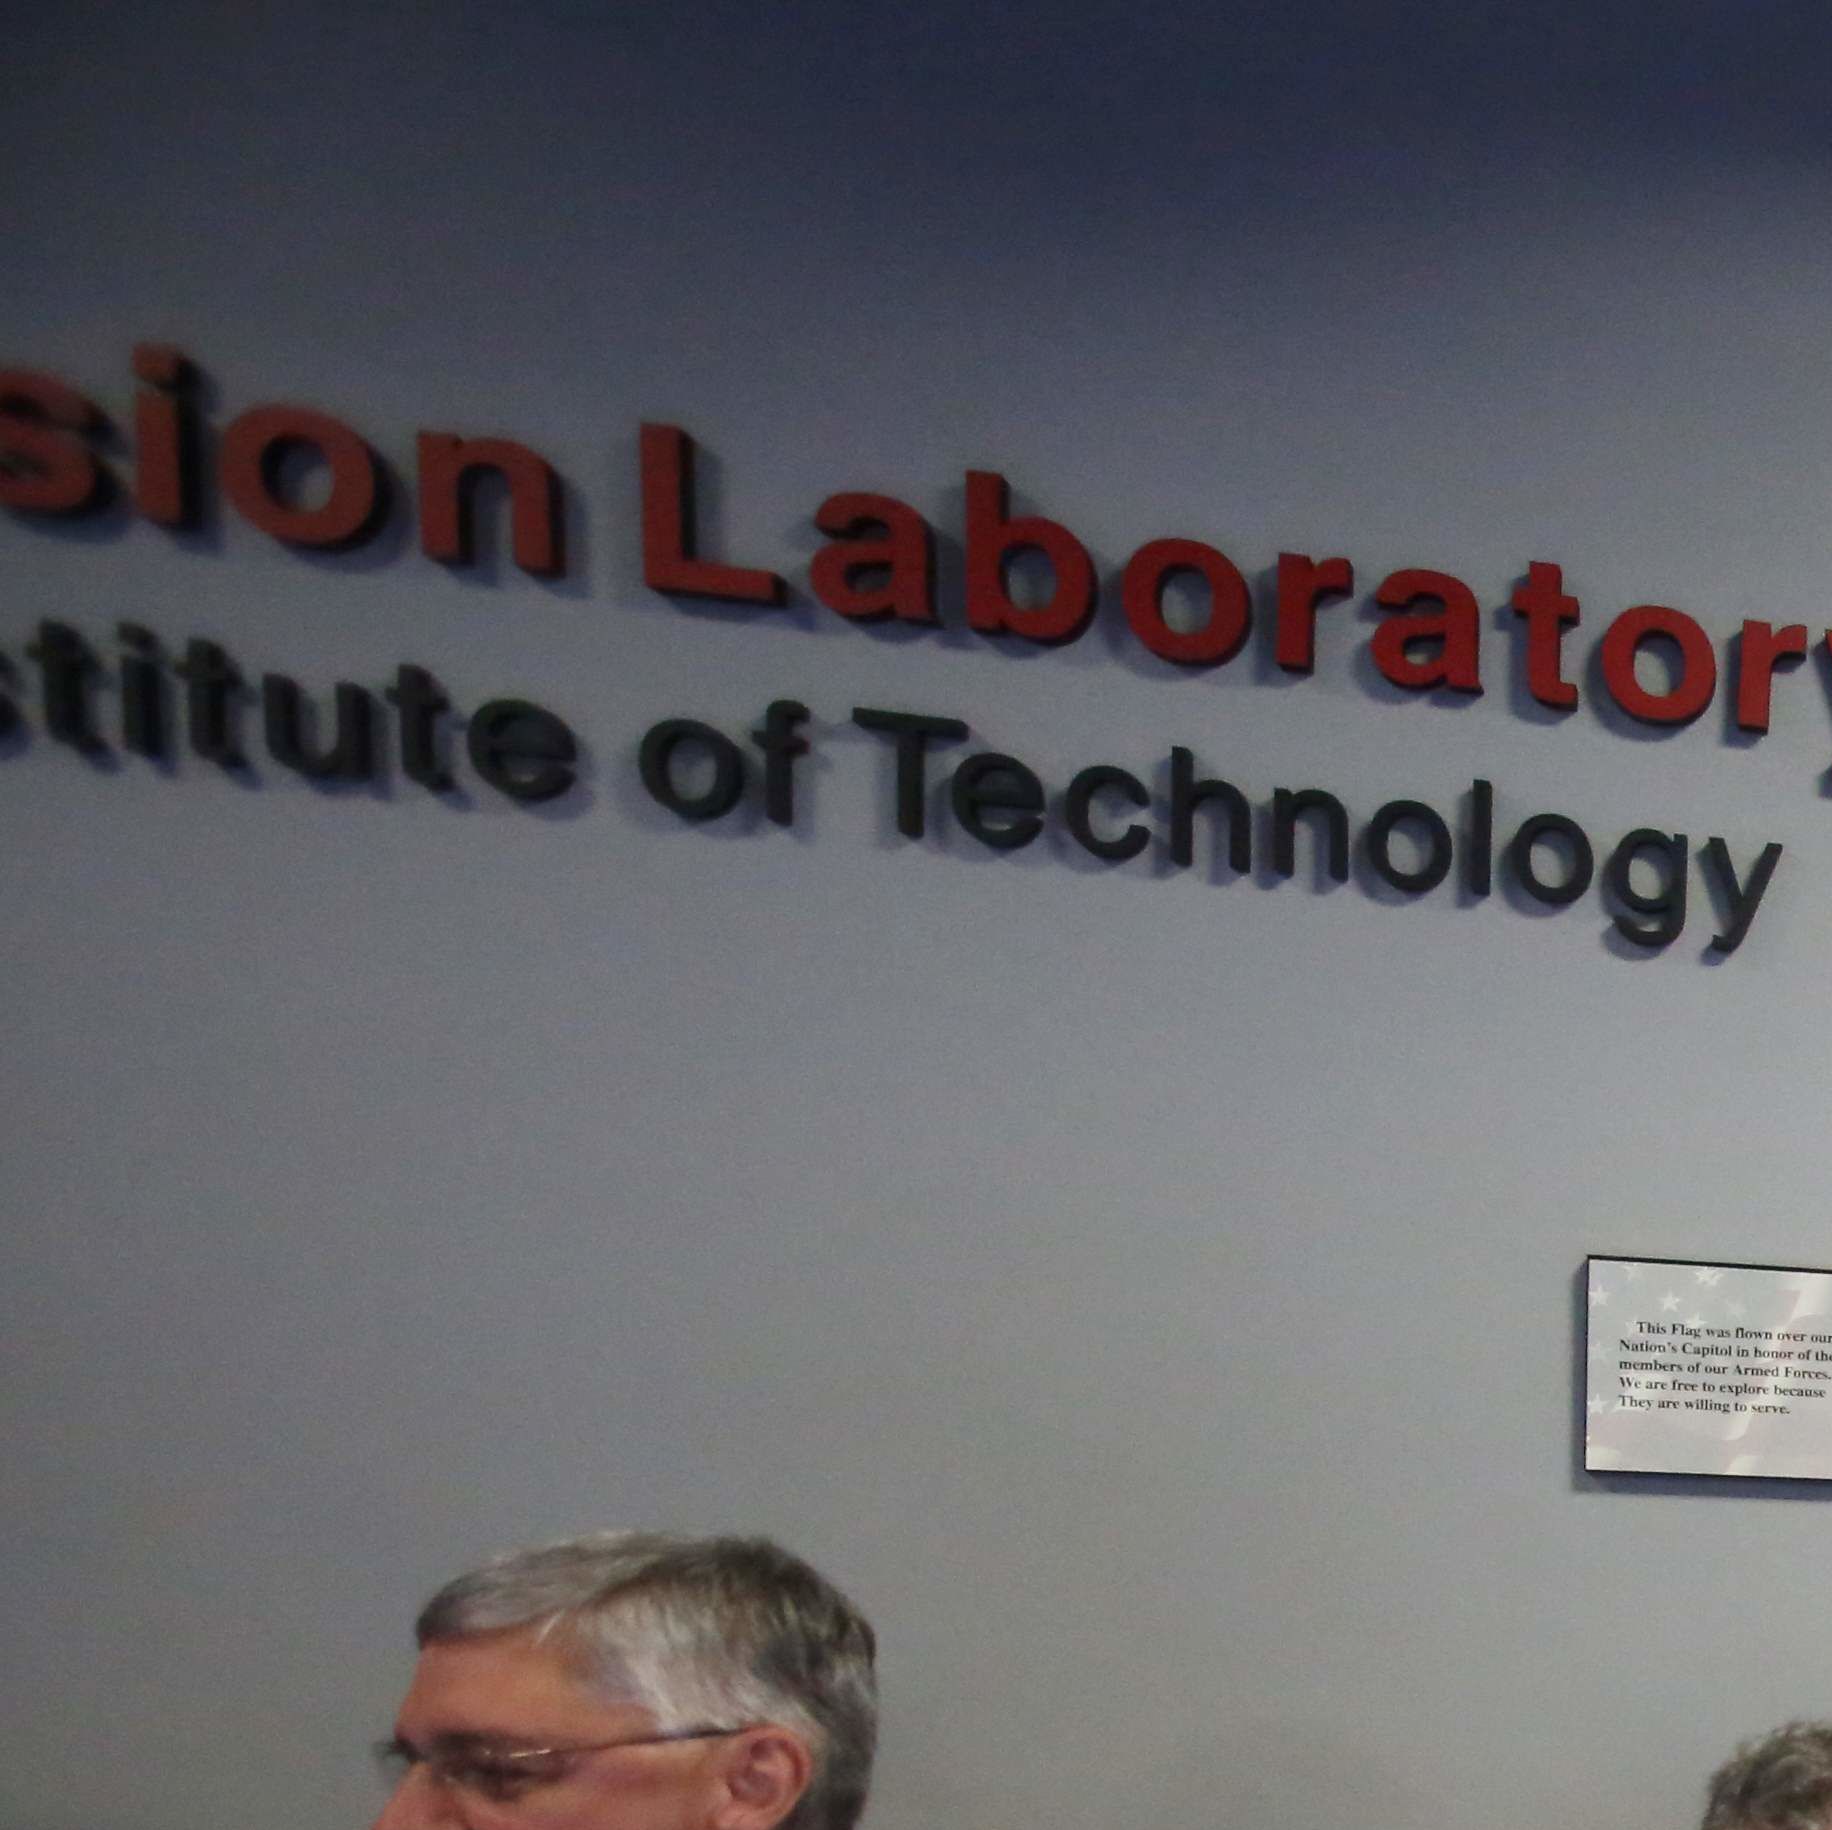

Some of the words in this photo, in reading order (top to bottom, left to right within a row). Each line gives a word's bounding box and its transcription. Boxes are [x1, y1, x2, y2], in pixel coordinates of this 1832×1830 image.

[0, 617, 578, 800] titute
[638, 700, 810, 828] of
[852, 706, 1784, 954] Technology
[1636, 1321, 1667, 1334] This
[1671, 1323, 1701, 1339] Flag
[1705, 1328, 1731, 1338] was
[1735, 1327, 1773, 1340] flown
[1777, 1332, 1807, 1342] over
[1619, 1339, 1678, 1354] Nation's
[1682, 1342, 1732, 1358] Capitol
[1736, 1345, 1749, 1358] in
[1753, 1346, 1794, 1360] honor
[1797, 1349, 1812, 1361] of
[1619, 1359, 1683, 1372] members
[1687, 1362, 1702, 1373] of
[1704, 1366, 1728, 1374] our
[1734, 1364, 1779, 1377] Armed
[1784, 1366, 1832, 1380] Forces.
[1619, 1376, 1642, 1389] We
[1645, 1381, 1668, 1390] are
[1671, 1379, 1699, 1392] free
[1702, 1382, 1716, 1392] to
[1719, 1383, 1769, 1397] explore
[1774, 1385, 1827, 1398] because
[1618, 1394, 1654, 1411] They
[1657, 1399, 1680, 1409] are
[1684, 1399, 1730, 1413] willing
[1734, 1402, 1748, 1412] to
[1751, 1405, 1791, 1415] serve.
